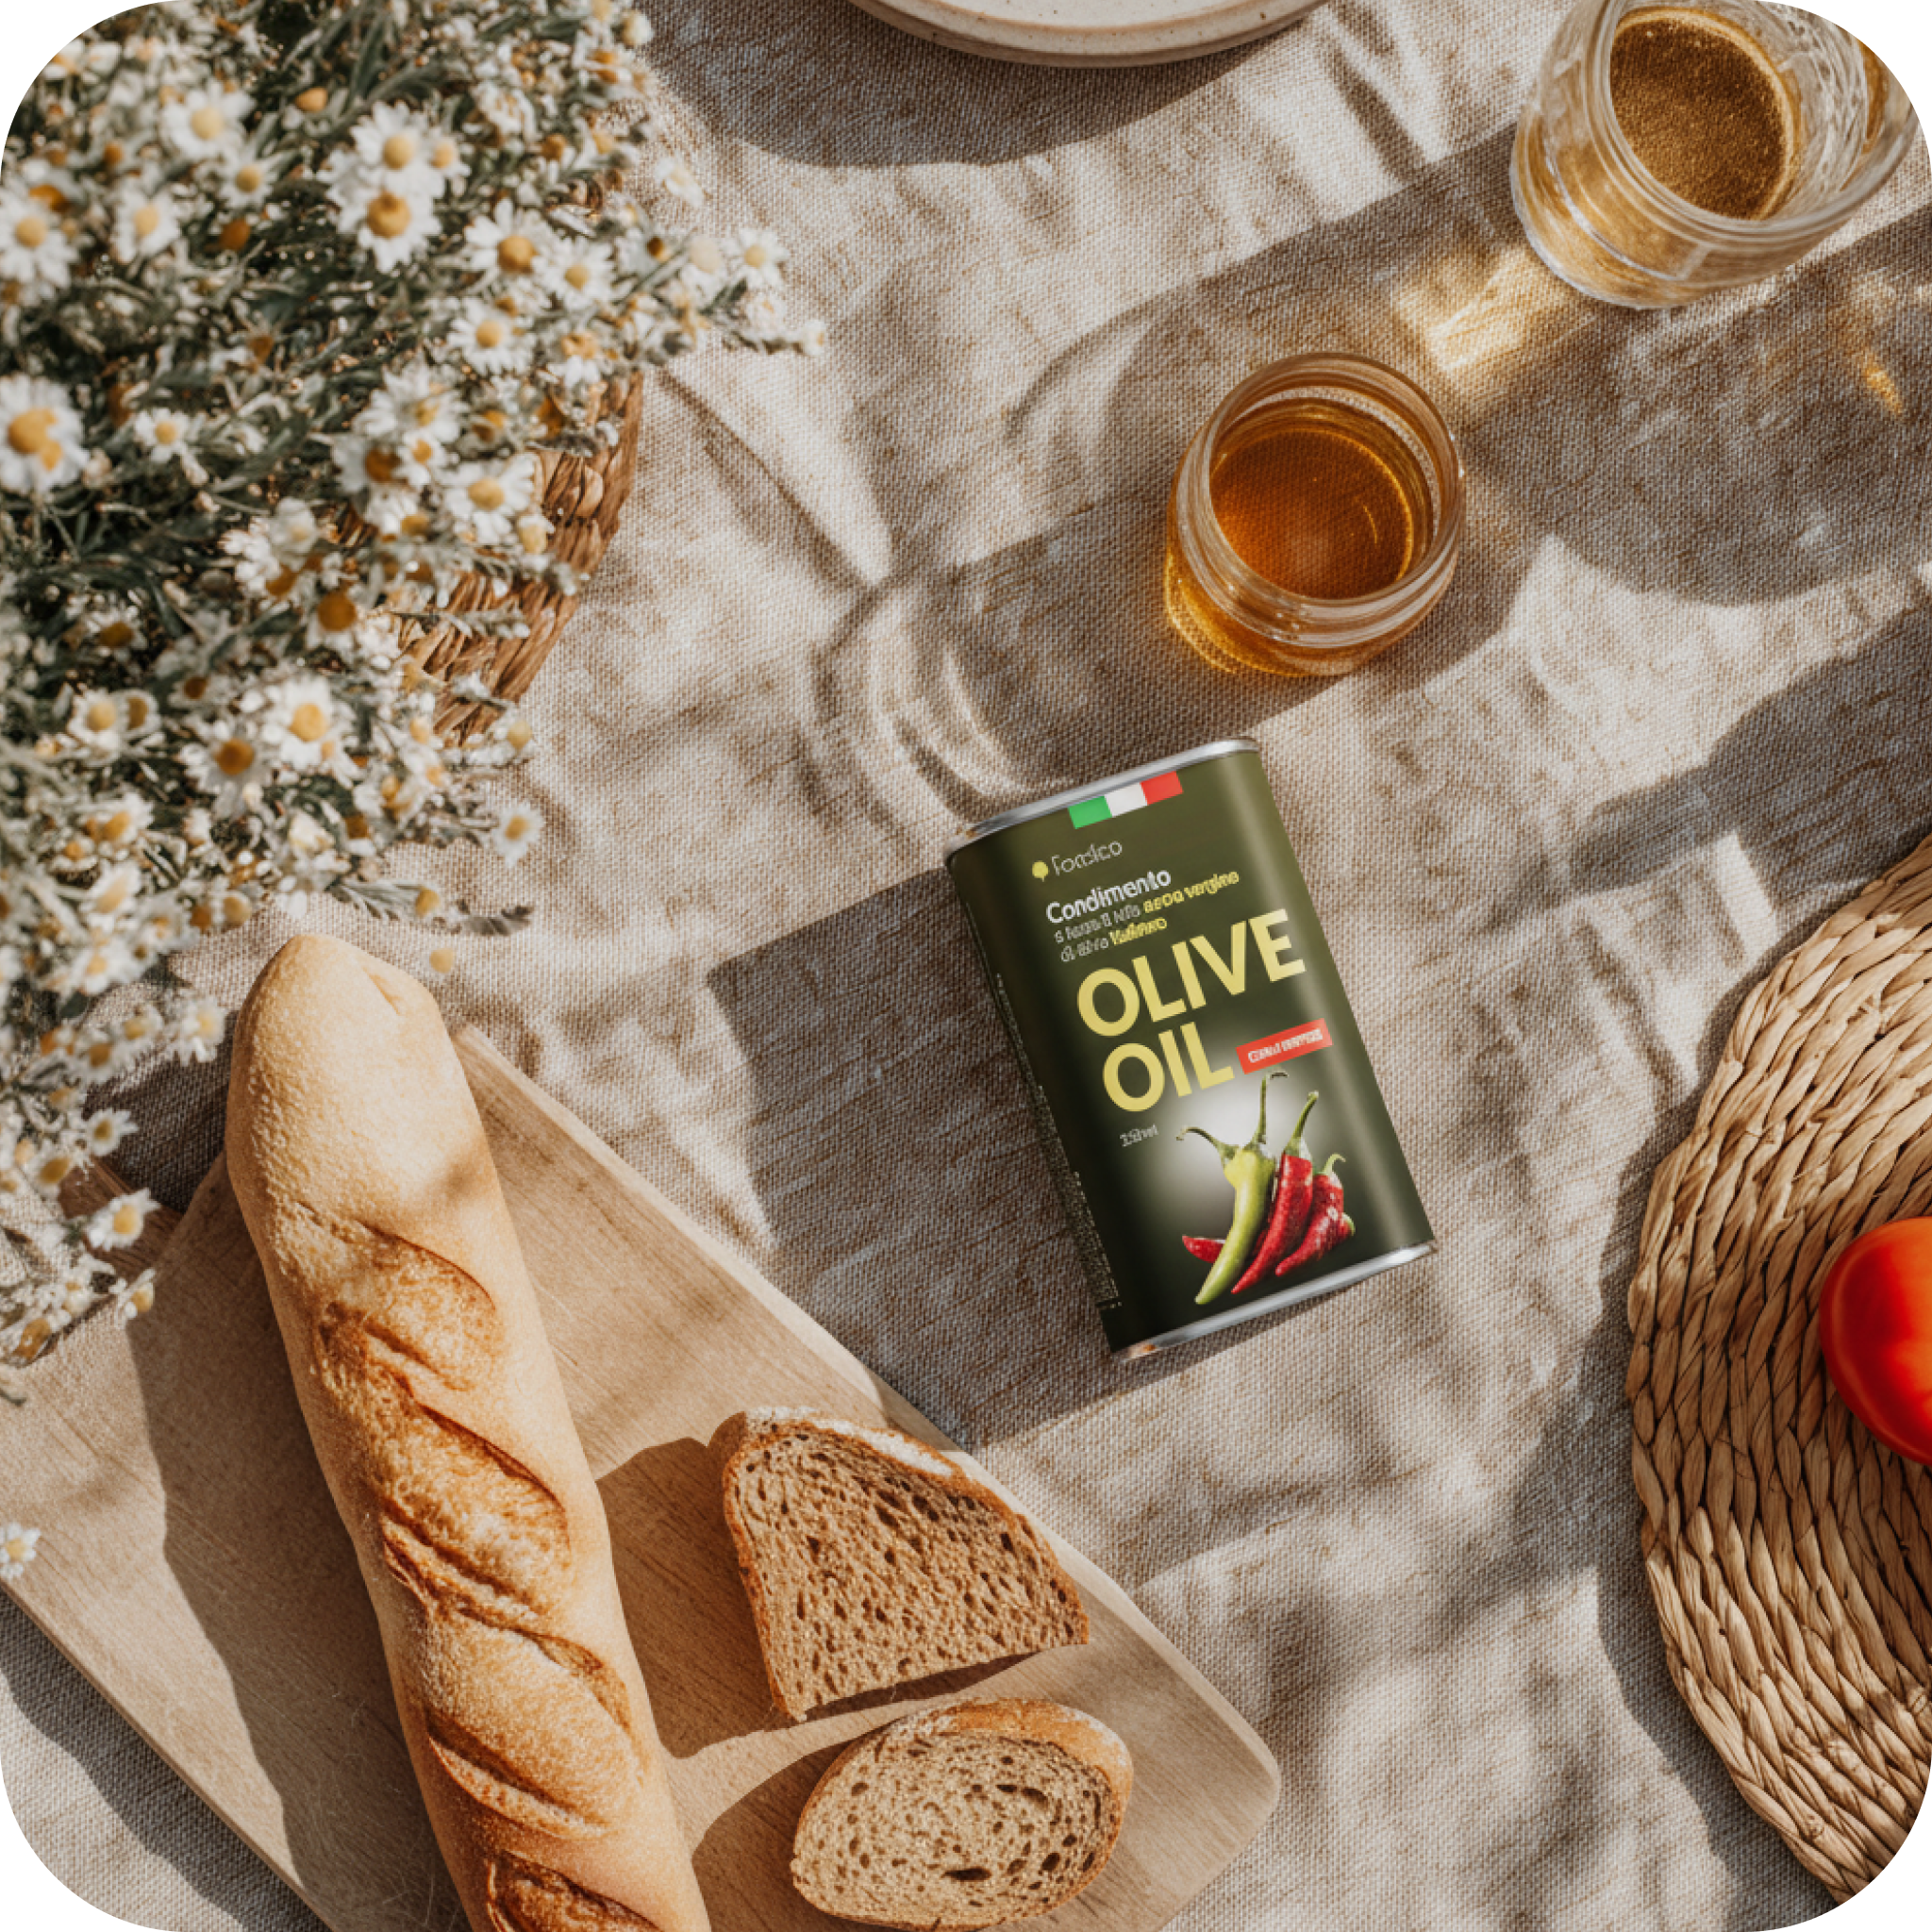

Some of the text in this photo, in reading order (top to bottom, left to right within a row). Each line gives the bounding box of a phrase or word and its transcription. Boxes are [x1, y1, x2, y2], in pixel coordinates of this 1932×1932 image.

[1045, 870, 1172, 924] Condimento
[1076, 908, 1307, 1037] OLIVE
[1102, 1021, 1236, 1112] OIL
